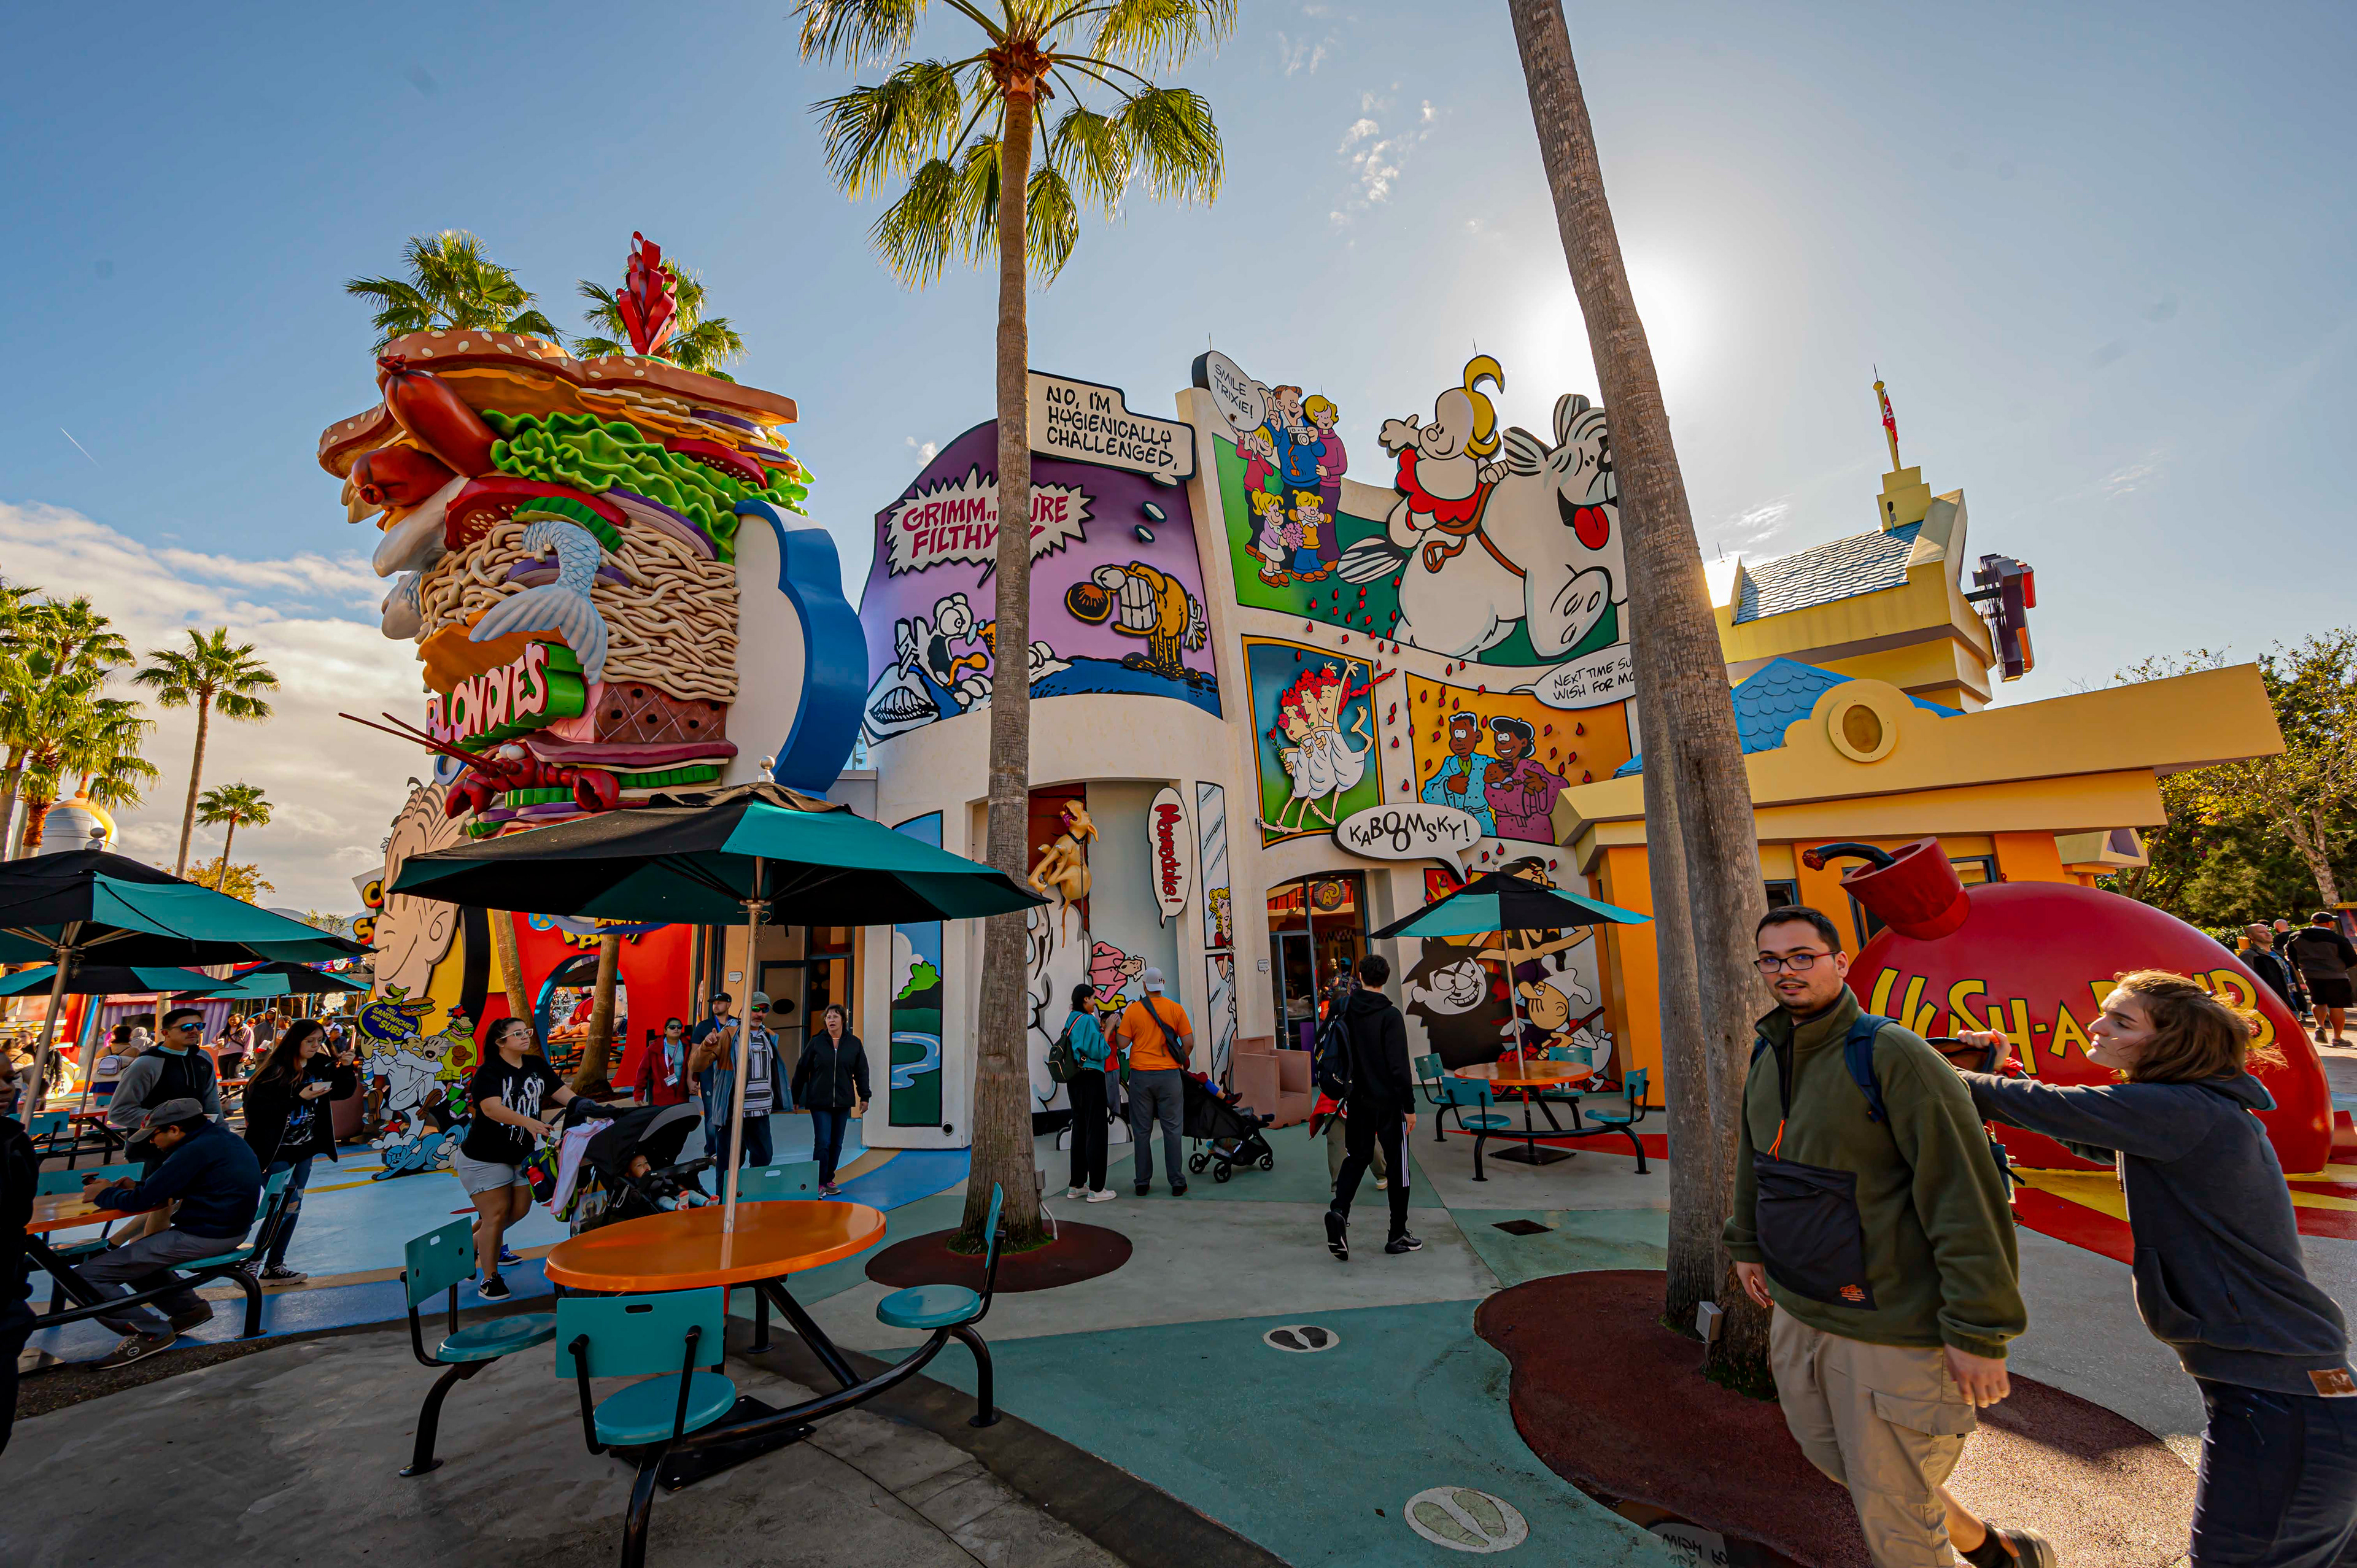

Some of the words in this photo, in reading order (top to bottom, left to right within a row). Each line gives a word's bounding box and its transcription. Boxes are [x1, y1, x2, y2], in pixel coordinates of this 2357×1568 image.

[1215, 364, 1247, 396] SMILE
[1047, 385, 1080, 409] NO,
[1089, 392, 1110, 414] I'M
[1213, 375, 1253, 419] TRIXIE!
[1048, 406, 1172, 450] HYGIENICALLY
[1047, 426, 1178, 470] CHALLENGED,
[1553, 684, 1586, 700] WISH
[1592, 678, 1614, 693] FOR
[1554, 668, 1585, 689] NEXT
[1586, 662, 1614, 678] TIME
[1349, 811, 1470, 852] KABOOMSKY!
[372, 1006, 416, 1031] SANDWICHES
[386, 1006, 398, 1016] DELI
[378, 1019, 404, 1037] SUBS
